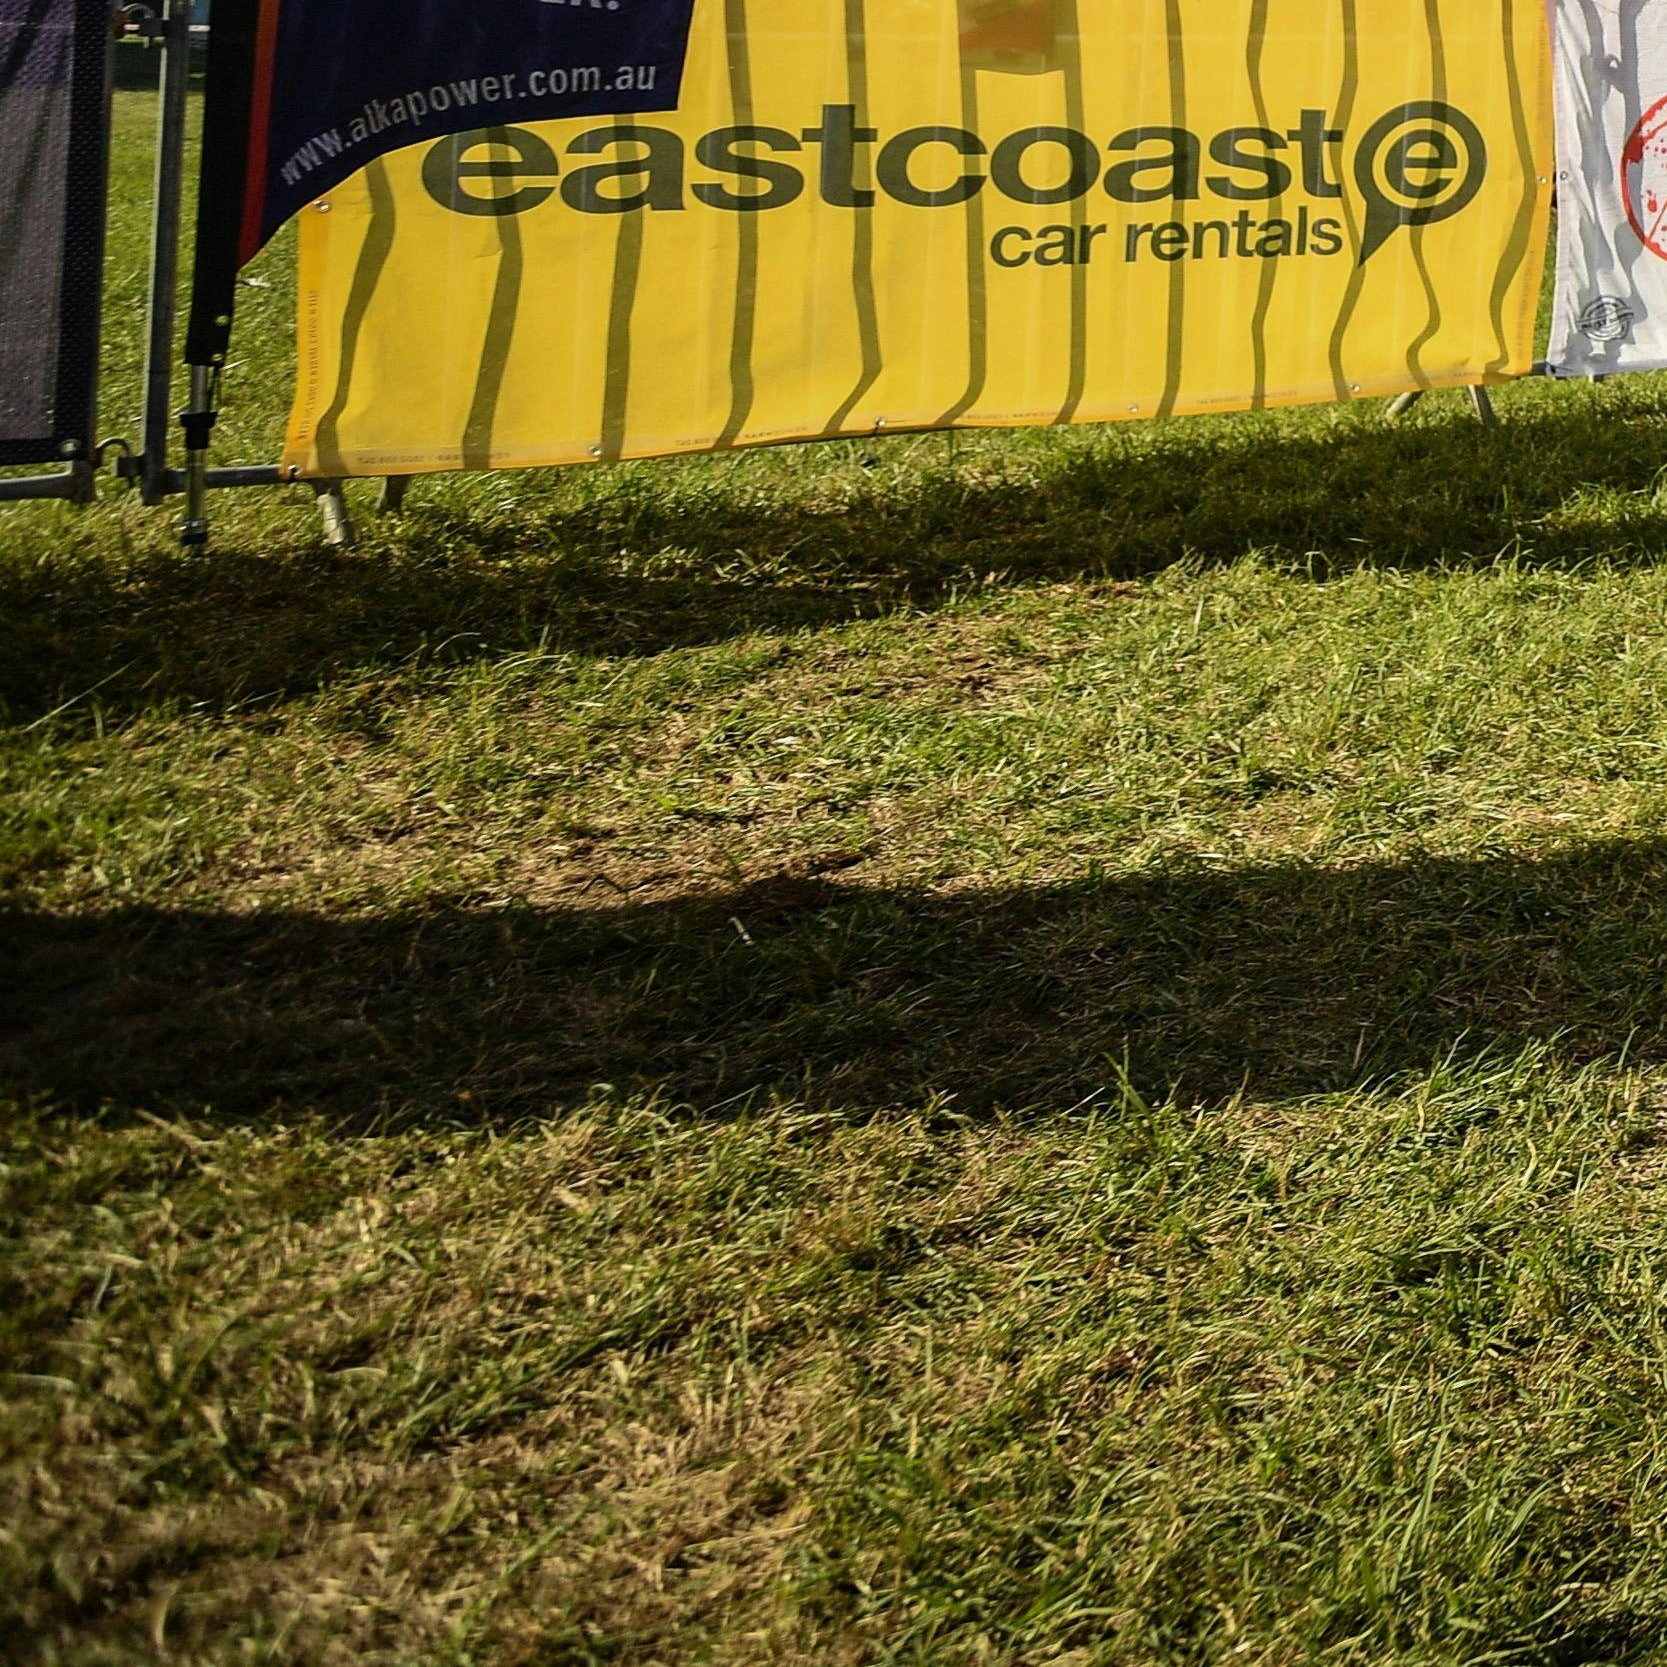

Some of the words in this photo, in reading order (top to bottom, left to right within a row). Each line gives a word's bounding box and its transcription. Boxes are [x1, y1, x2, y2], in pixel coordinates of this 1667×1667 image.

[281, 64, 657, 187] www.alkapower.com.au
[420, 103, 1345, 217] eastcoast
[988, 222, 1107, 268] car
[1123, 205, 1343, 264] rentals
